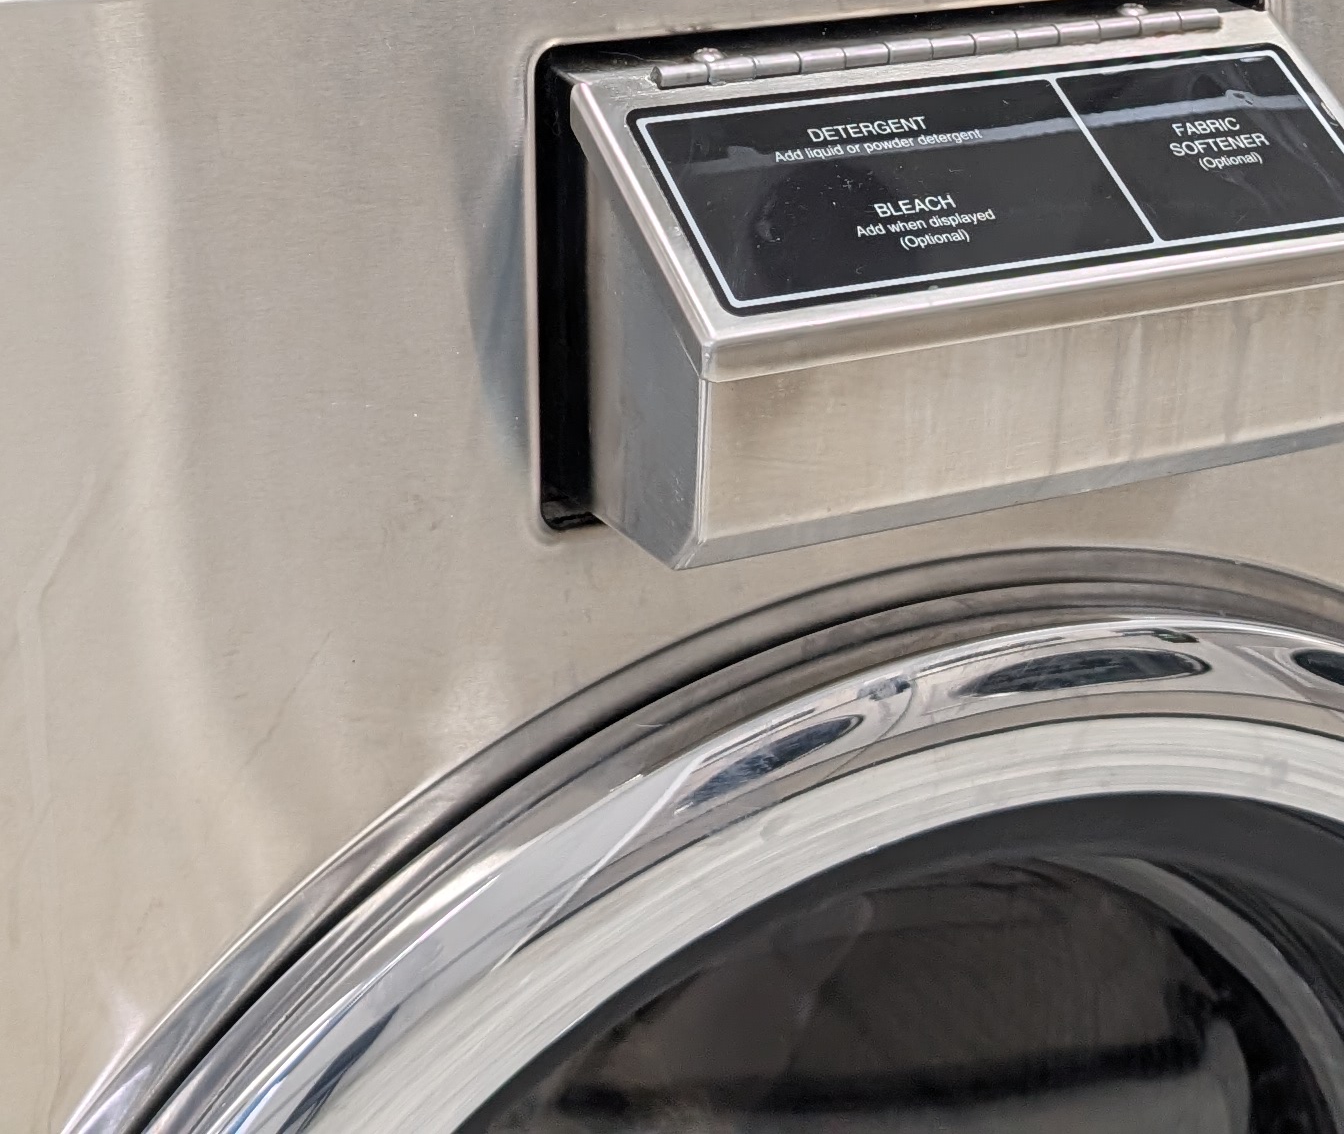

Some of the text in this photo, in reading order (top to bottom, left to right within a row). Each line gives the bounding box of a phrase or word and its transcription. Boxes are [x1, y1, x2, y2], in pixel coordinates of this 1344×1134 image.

[807, 116, 929, 143] DETERGENT
[1172, 117, 1240, 137] FABRIC
[775, 128, 983, 163] Add liquid or powder detergent
[1170, 133, 1270, 157] SOFTENER
[1199, 152, 1263, 172] (Optional)
[874, 194, 956, 218] BLEACH
[856, 208, 996, 238] Add when displayed
[900, 229, 970, 250] (Optional)
